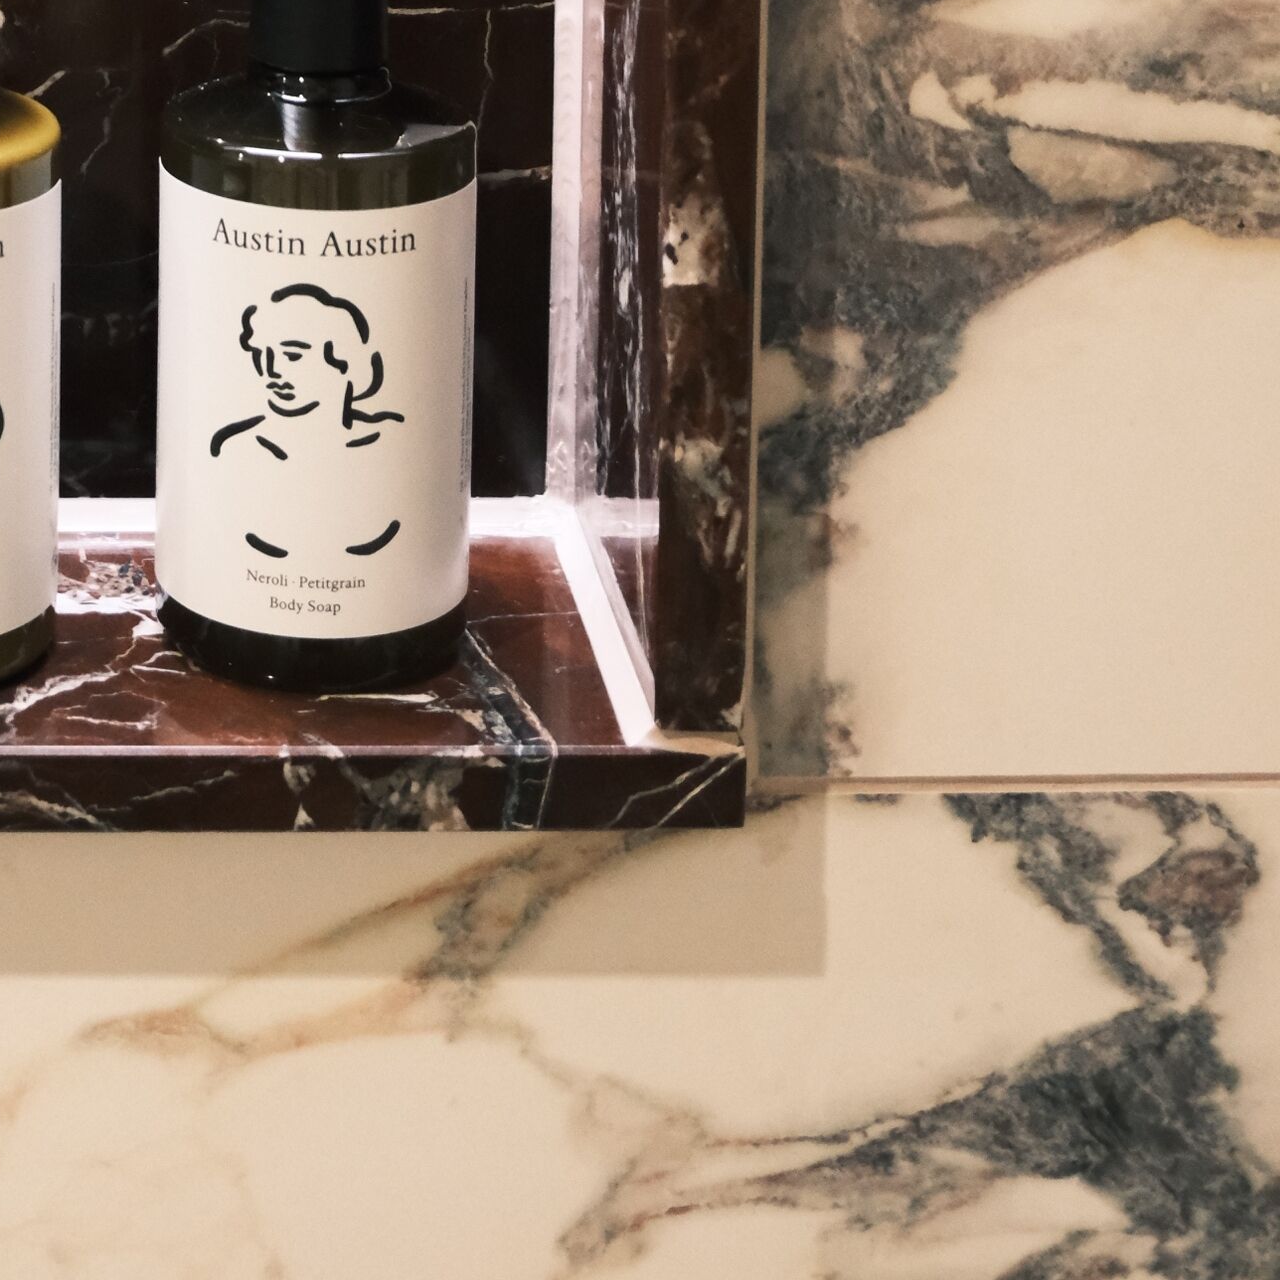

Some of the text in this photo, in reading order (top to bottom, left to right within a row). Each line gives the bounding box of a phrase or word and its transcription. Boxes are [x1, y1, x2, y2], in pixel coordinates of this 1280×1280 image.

[212, 216, 417, 258] Austin Austin
[246, 568, 366, 592] Neroli Petitgrain
[269, 596, 341, 616] Body Soap
